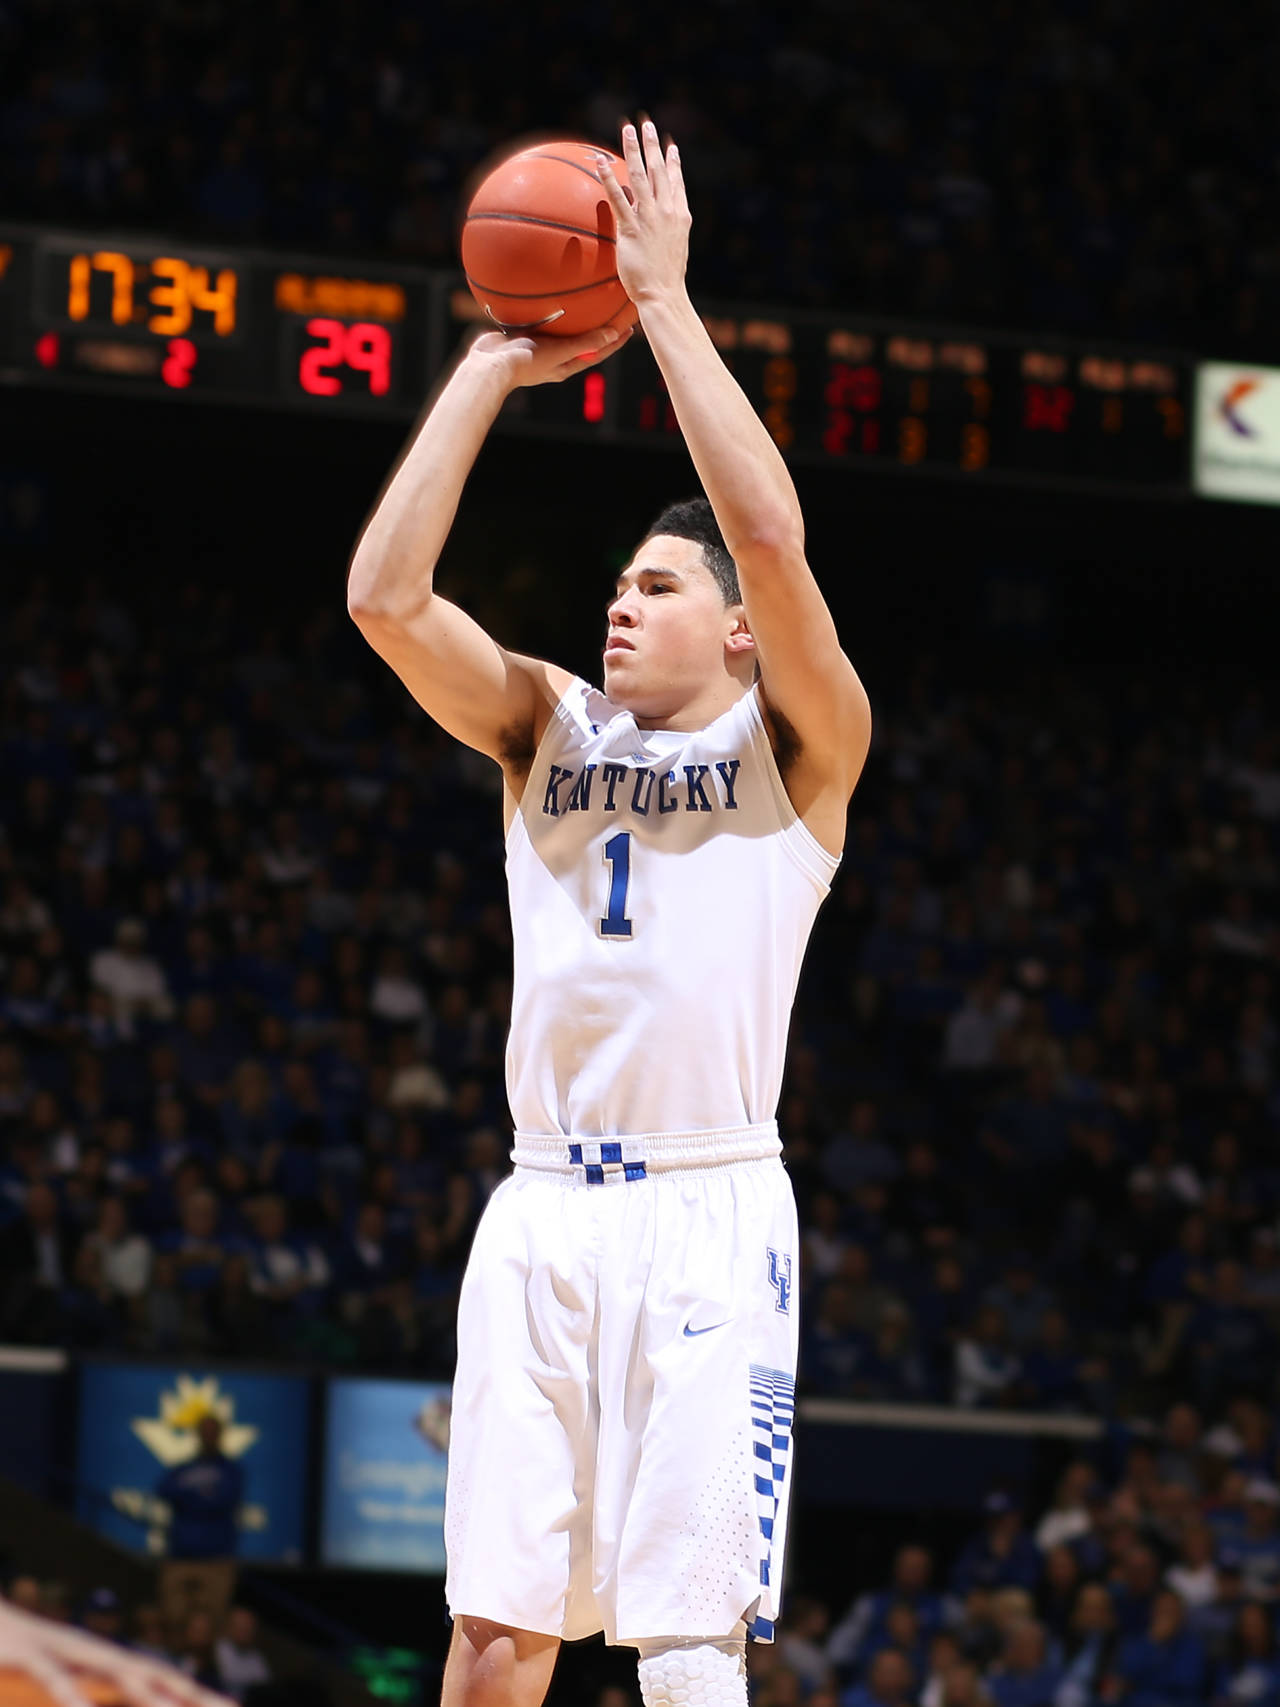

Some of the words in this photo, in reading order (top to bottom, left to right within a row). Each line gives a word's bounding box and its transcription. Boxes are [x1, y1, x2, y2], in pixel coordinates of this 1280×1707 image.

[68, 251, 238, 337] 17:34
[161, 337, 198, 389] 2
[299, 318, 392, 396] 29
[583, 371, 606, 424] 1
[597, 829, 635, 939] 1
